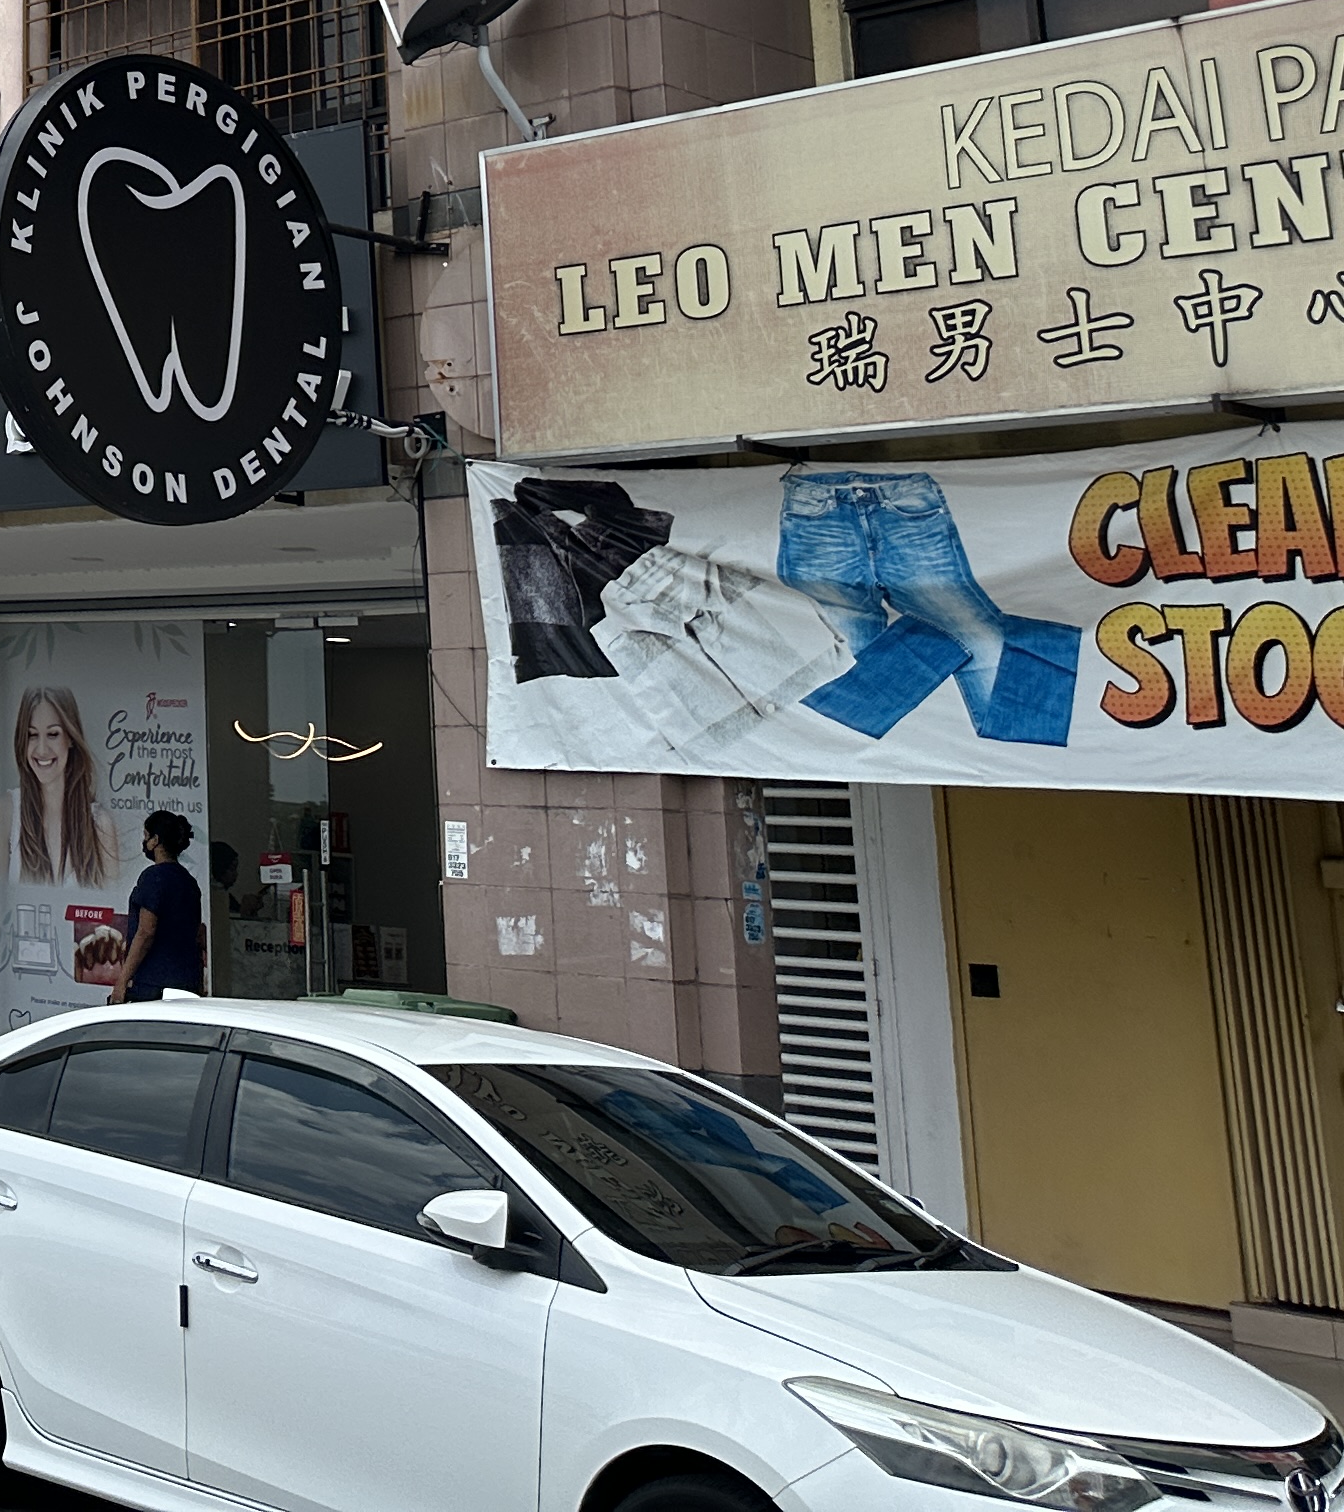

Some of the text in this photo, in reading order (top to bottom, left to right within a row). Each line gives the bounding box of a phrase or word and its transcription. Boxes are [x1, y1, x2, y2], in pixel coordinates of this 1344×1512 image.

[940, 56, 1229, 190] KEDAI
[11, 70, 326, 290] KLINIK PERGIGIAN
[554, 150, 1344, 337] LEO MEN CEN
[15, 300, 327, 505] JOHNSON DENTAL
[105, 709, 194, 759] Experience
[137, 745, 194, 760] the most
[107, 751, 201, 799] Comfortable
[110, 796, 203, 814] scaling with us
[75, 908, 103, 920] BEFORE
